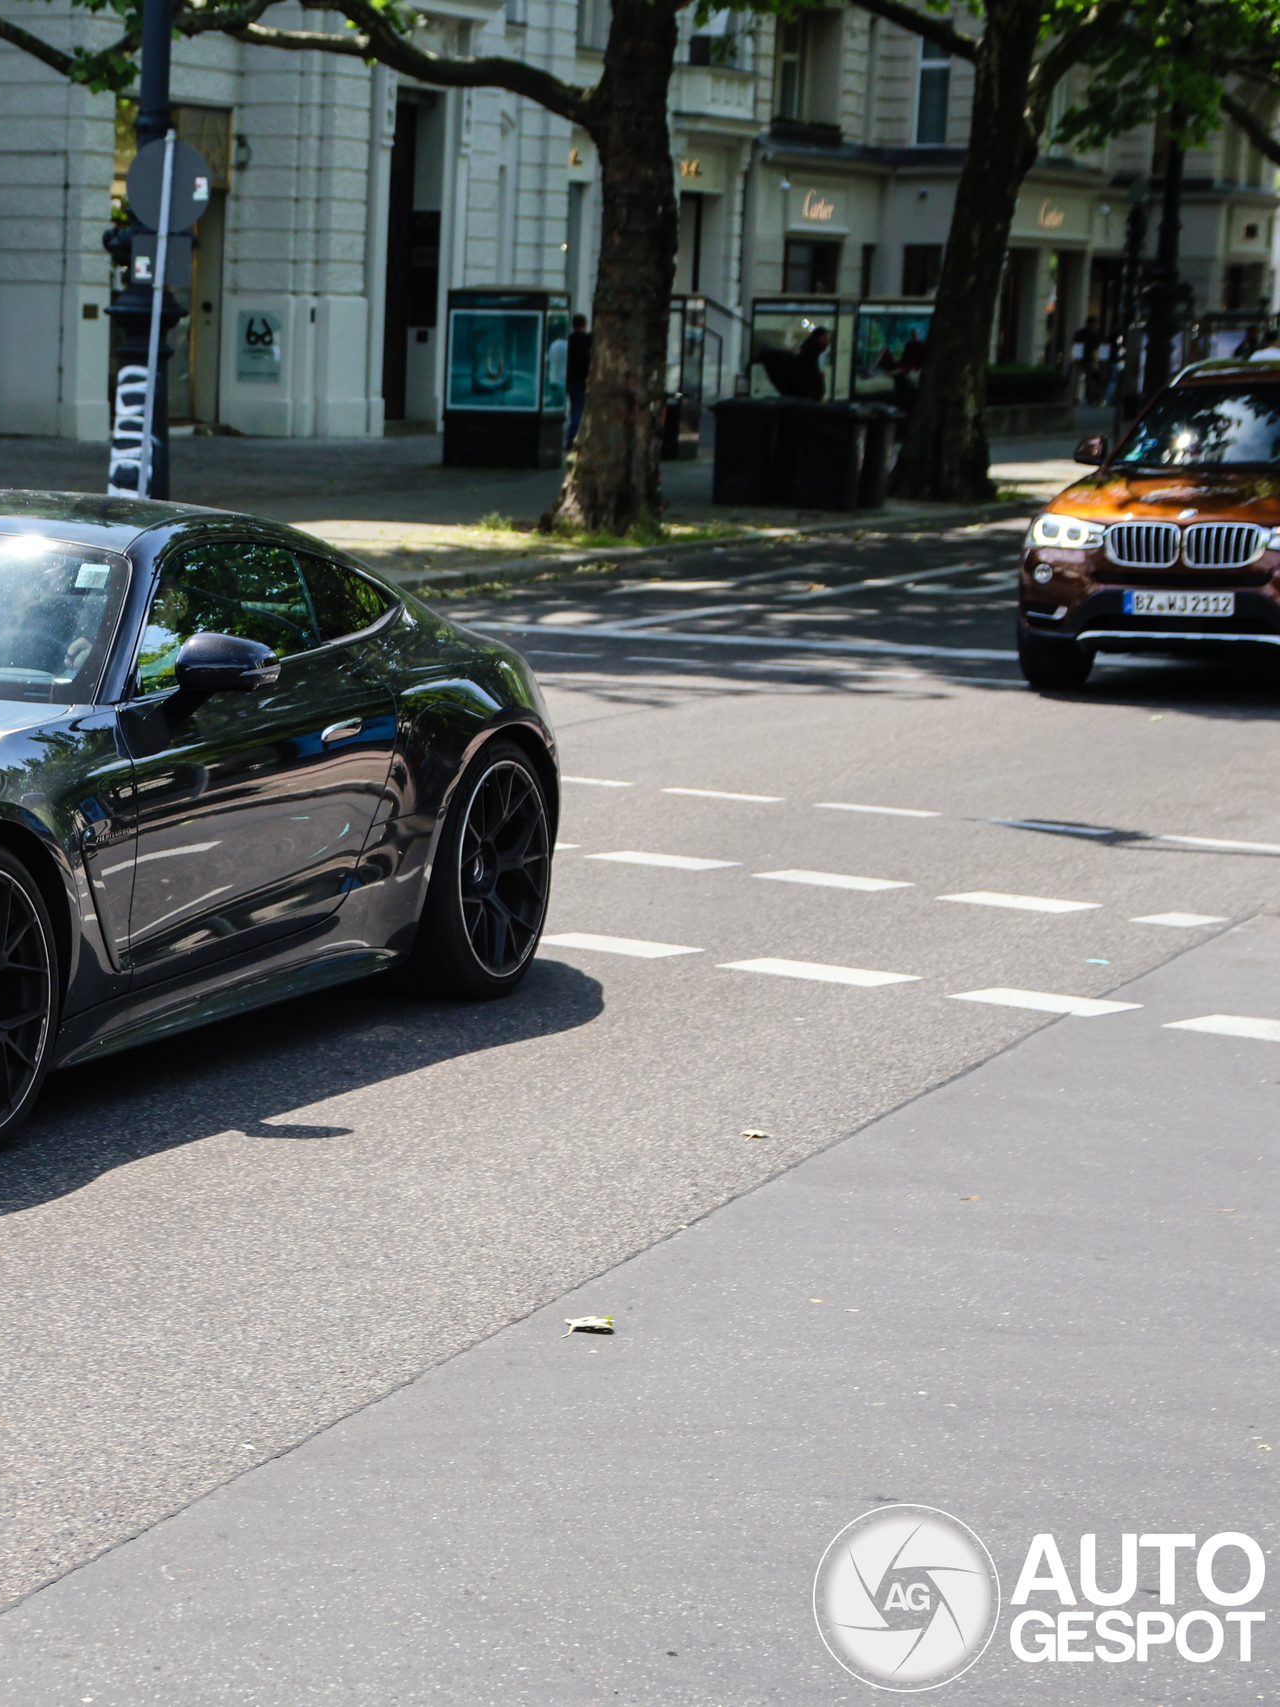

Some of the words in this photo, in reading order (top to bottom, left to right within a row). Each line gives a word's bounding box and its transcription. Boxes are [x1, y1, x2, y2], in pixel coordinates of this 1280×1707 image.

[802, 188, 835, 220] Cartier
[1135, 594, 1155, 612] BZ
[1166, 594, 1187, 612] WJ
[1191, 595, 1232, 614] 2112
